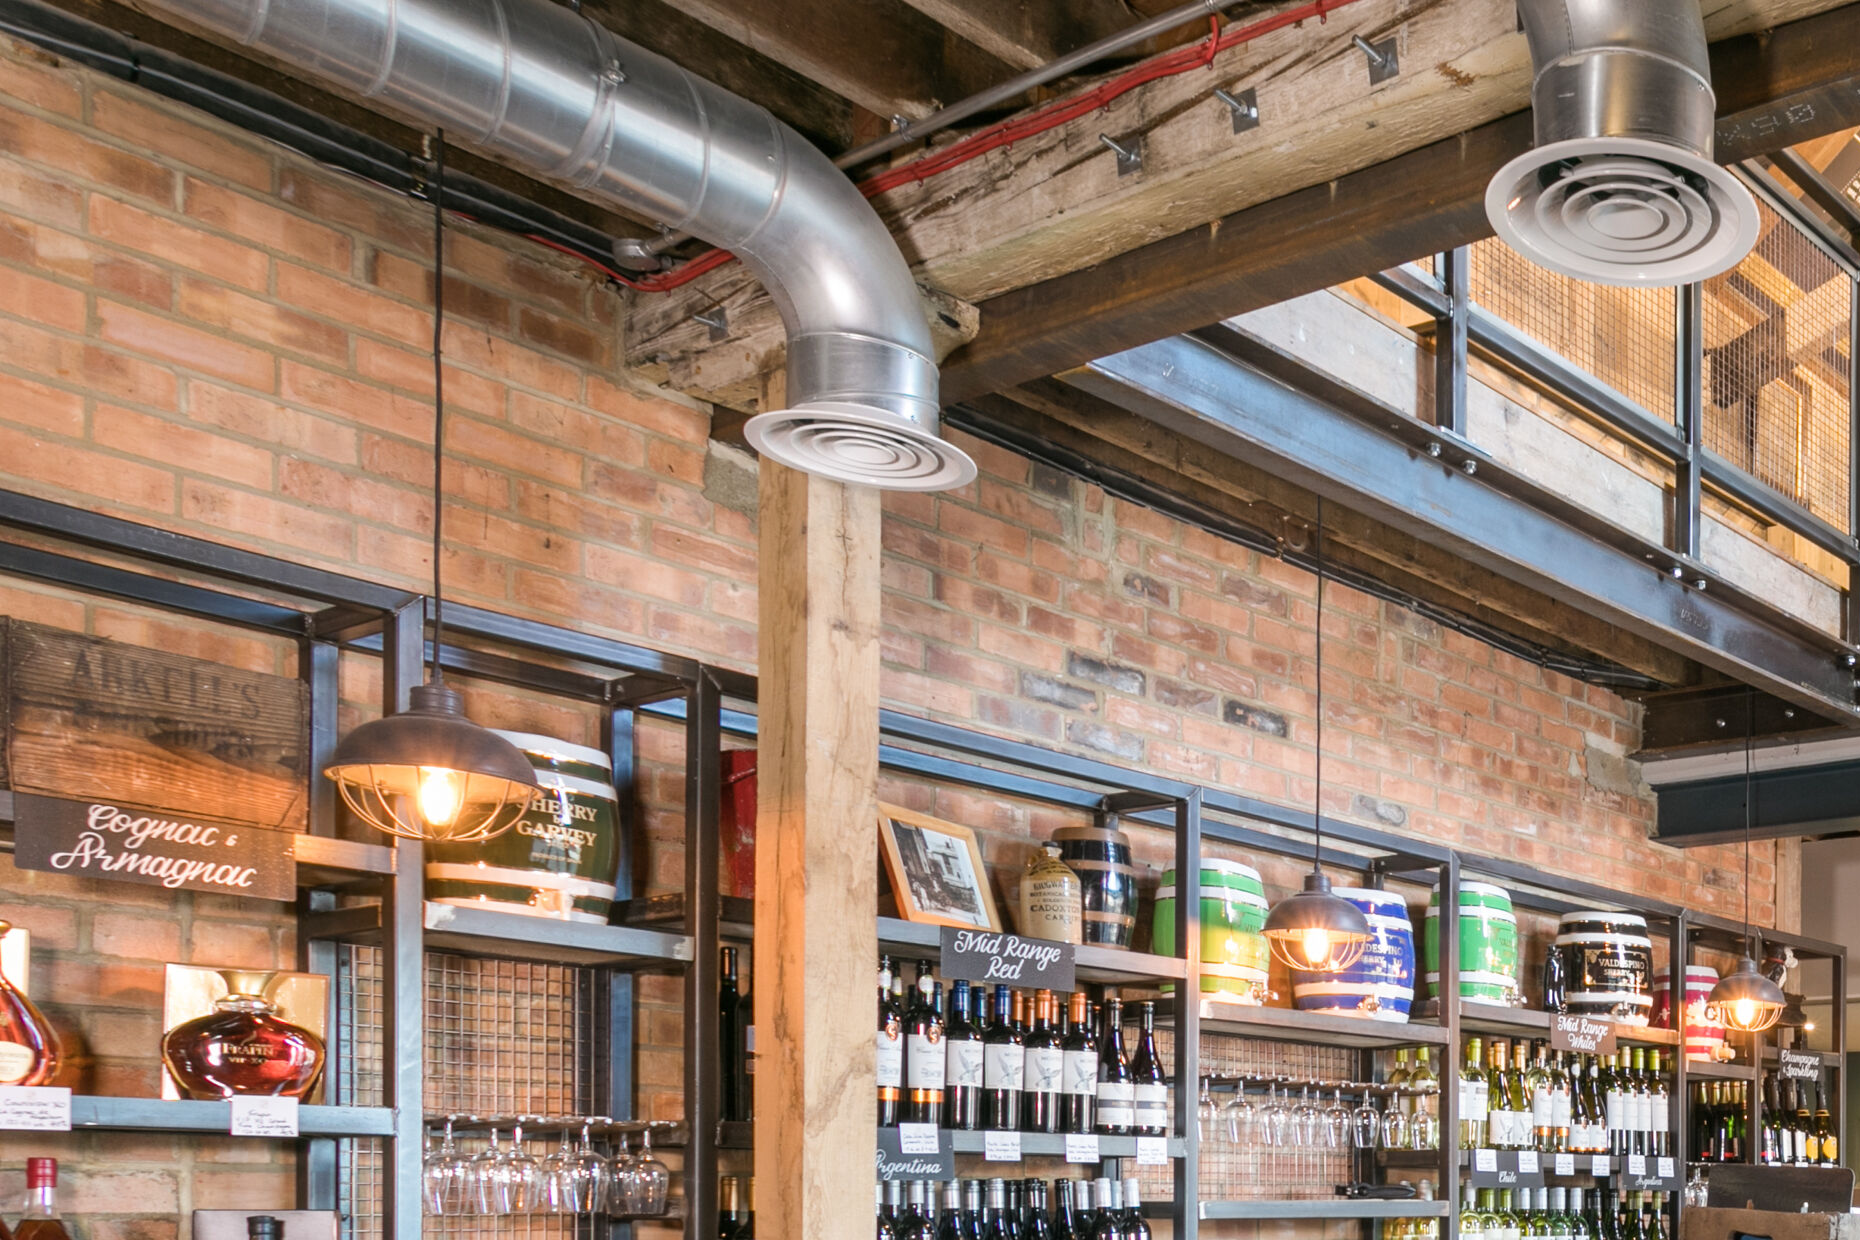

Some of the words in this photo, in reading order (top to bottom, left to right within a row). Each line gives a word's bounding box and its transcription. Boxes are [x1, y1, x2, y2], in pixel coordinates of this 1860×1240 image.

[88, 804, 220, 849] Cognac
[516, 820, 597, 847] GARVEY
[50, 831, 258, 888] Armagnac
[955, 930, 1000, 955] Mid
[1003, 935, 1061, 972] Range
[984, 957, 1022, 982] Red
[1557, 1016, 1578, 1032] Mid
[1580, 1019, 1609, 1043] Range
[1567, 1033, 1597, 1051] Whites
[1781, 1049, 1819, 1066] Champagne
[1786, 1063, 1819, 1082] Sparkling
[1498, 1170, 1517, 1184] Chile
